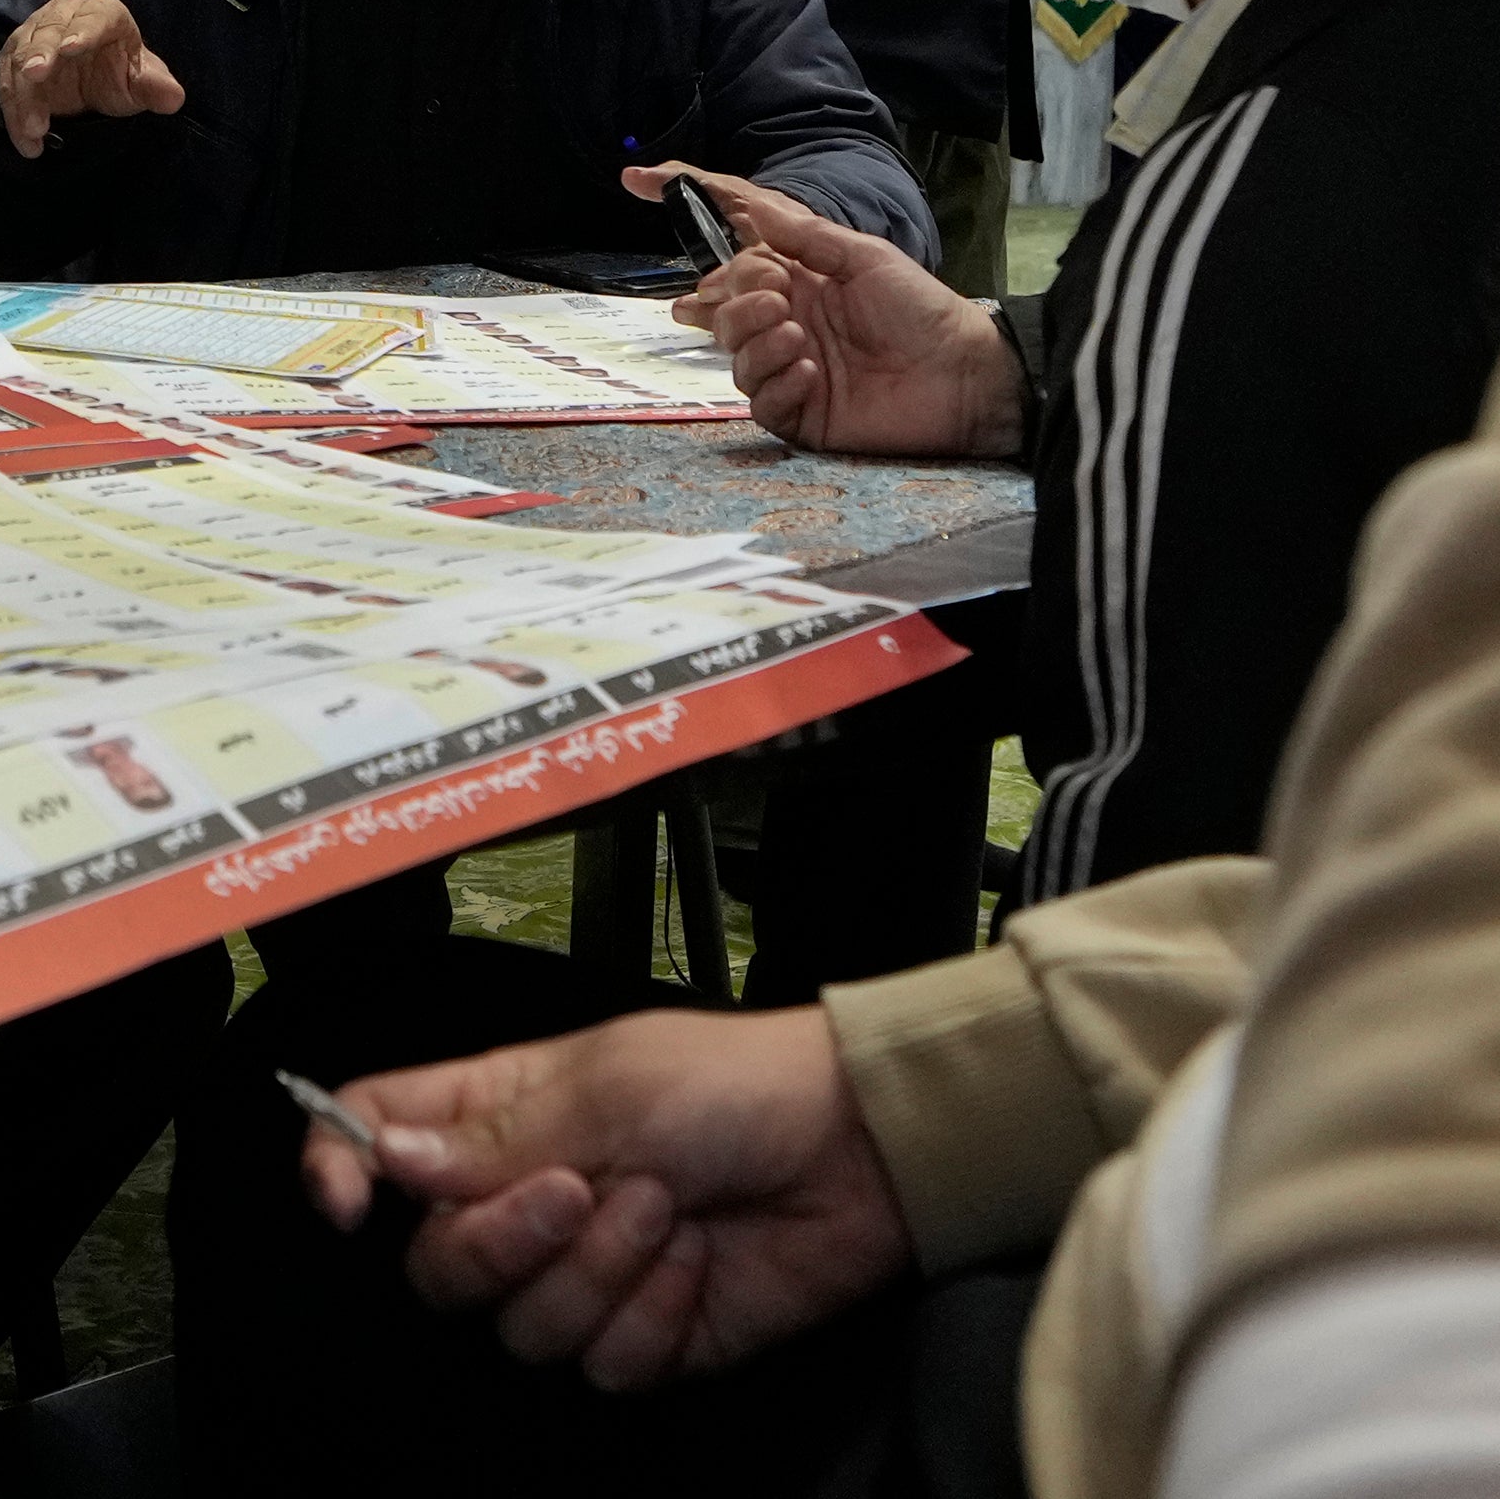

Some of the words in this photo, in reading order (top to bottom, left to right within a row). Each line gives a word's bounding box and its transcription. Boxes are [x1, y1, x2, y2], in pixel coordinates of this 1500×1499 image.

[204, 821, 340, 898] دوازدهمین
[342, 803, 402, 846] دوره
[400, 780, 488, 833] انتخابات
[485, 746, 553, 792] مجلس
[557, 725, 620, 773] شورای
[622, 699, 688, 752] اسلامی
